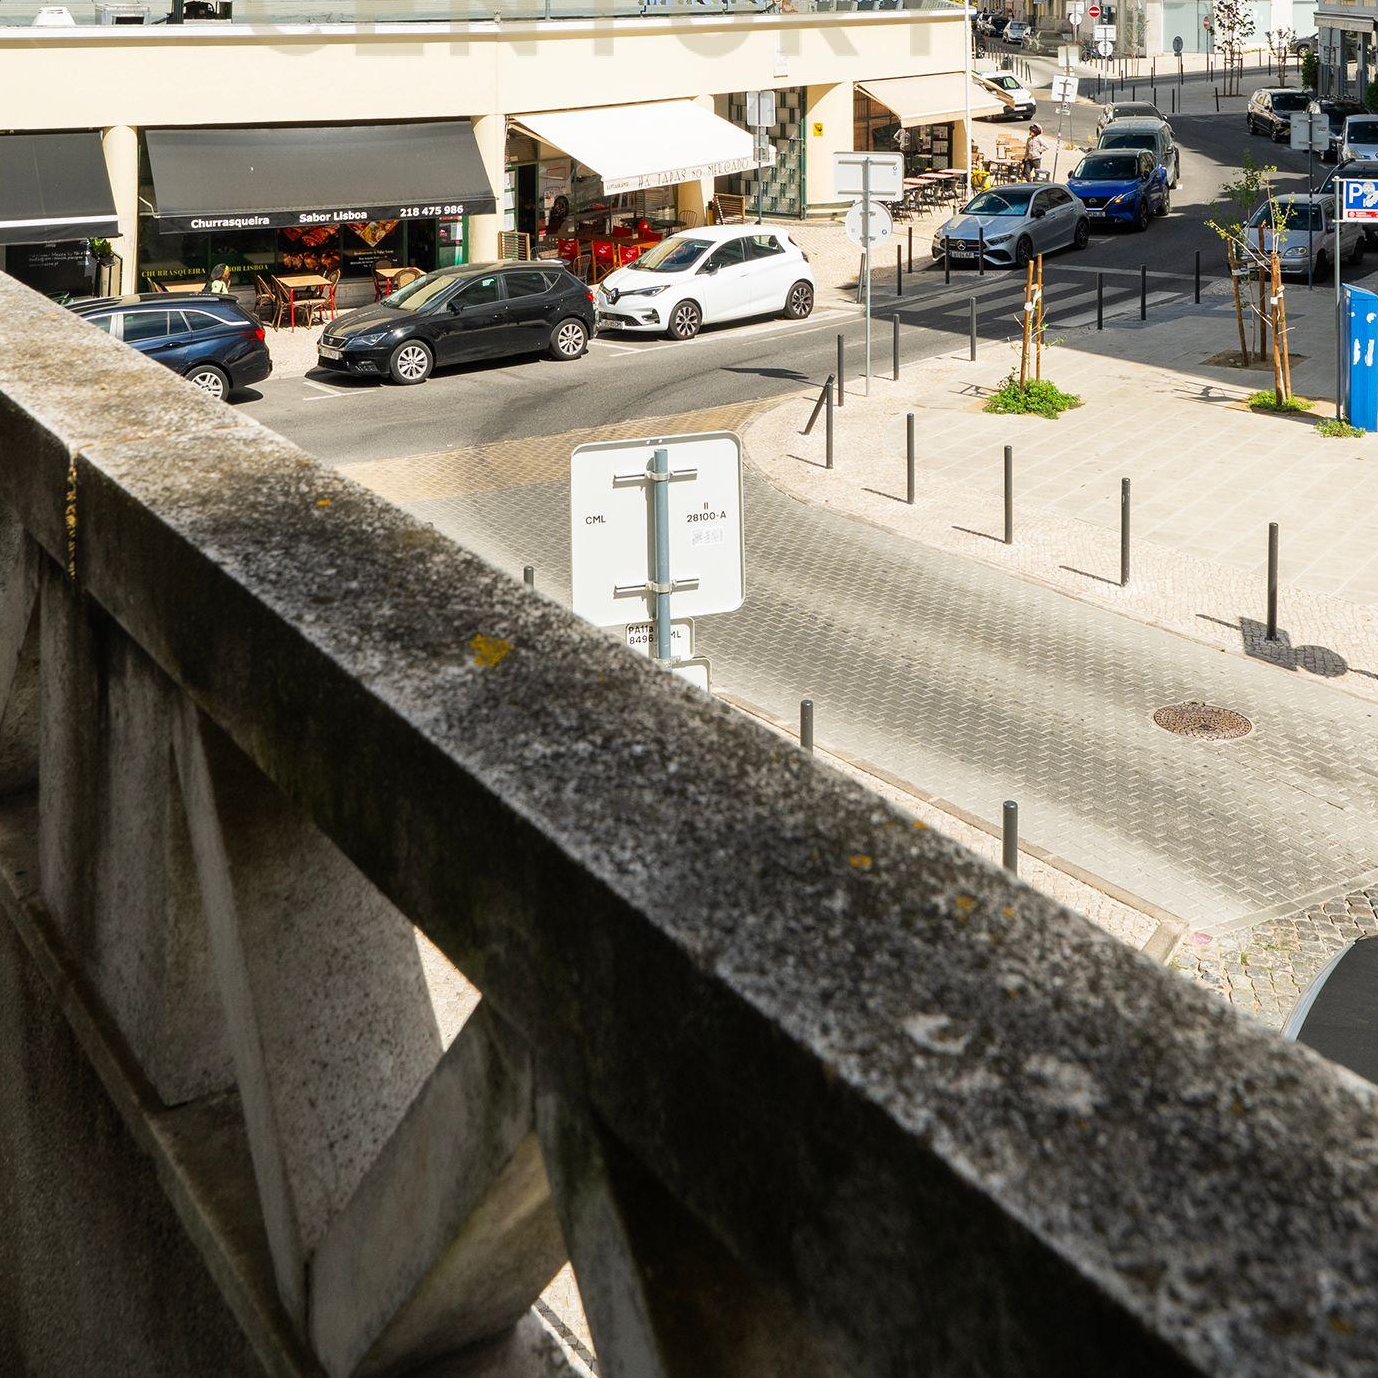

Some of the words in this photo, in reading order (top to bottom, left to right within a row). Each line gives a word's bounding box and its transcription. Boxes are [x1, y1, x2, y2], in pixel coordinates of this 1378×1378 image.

[191, 216, 270, 229] Churrasqueira
[299, 213, 332, 223] Sabor
[334, 210, 368, 221] Lisboa
[400, 207, 419, 218] 218
[421, 206, 442, 216] 475
[444, 205, 464, 215] 986
[585, 515, 606, 525] CML
[686, 511, 727, 523] 28100-A
